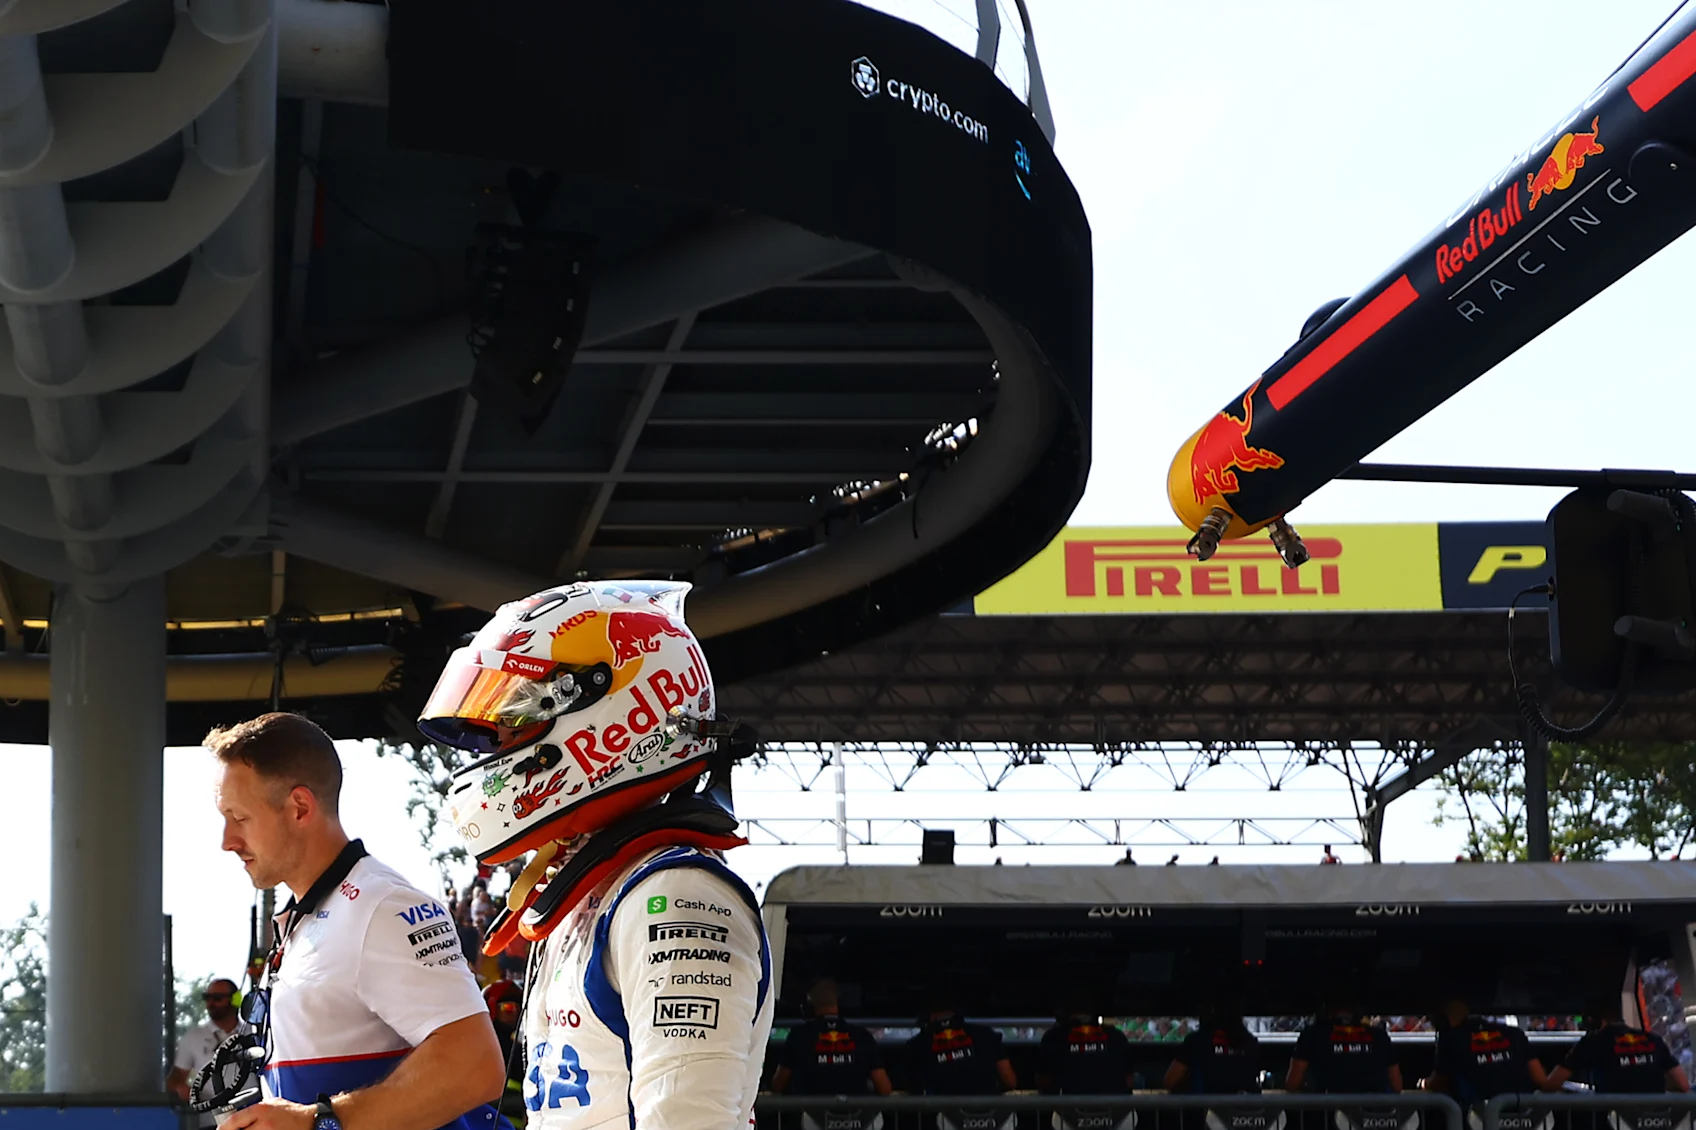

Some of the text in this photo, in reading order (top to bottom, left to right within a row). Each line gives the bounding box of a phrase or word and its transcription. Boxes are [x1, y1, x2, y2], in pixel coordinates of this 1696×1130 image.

[887, 77, 989, 143] crypto.com
[1456, 177, 1638, 322] RACING
[1064, 538, 1343, 597] PIRELLI
[518, 662, 545, 674] ORLEN
[587, 755, 624, 790] HRC
[395, 901, 446, 926] VISA
[674, 898, 732, 917] Cash App
[648, 921, 729, 943] PIRELLI
[671, 971, 732, 987] randstad
[660, 1003, 713, 1020] NEFT
[663, 1028, 707, 1040] VODKA
